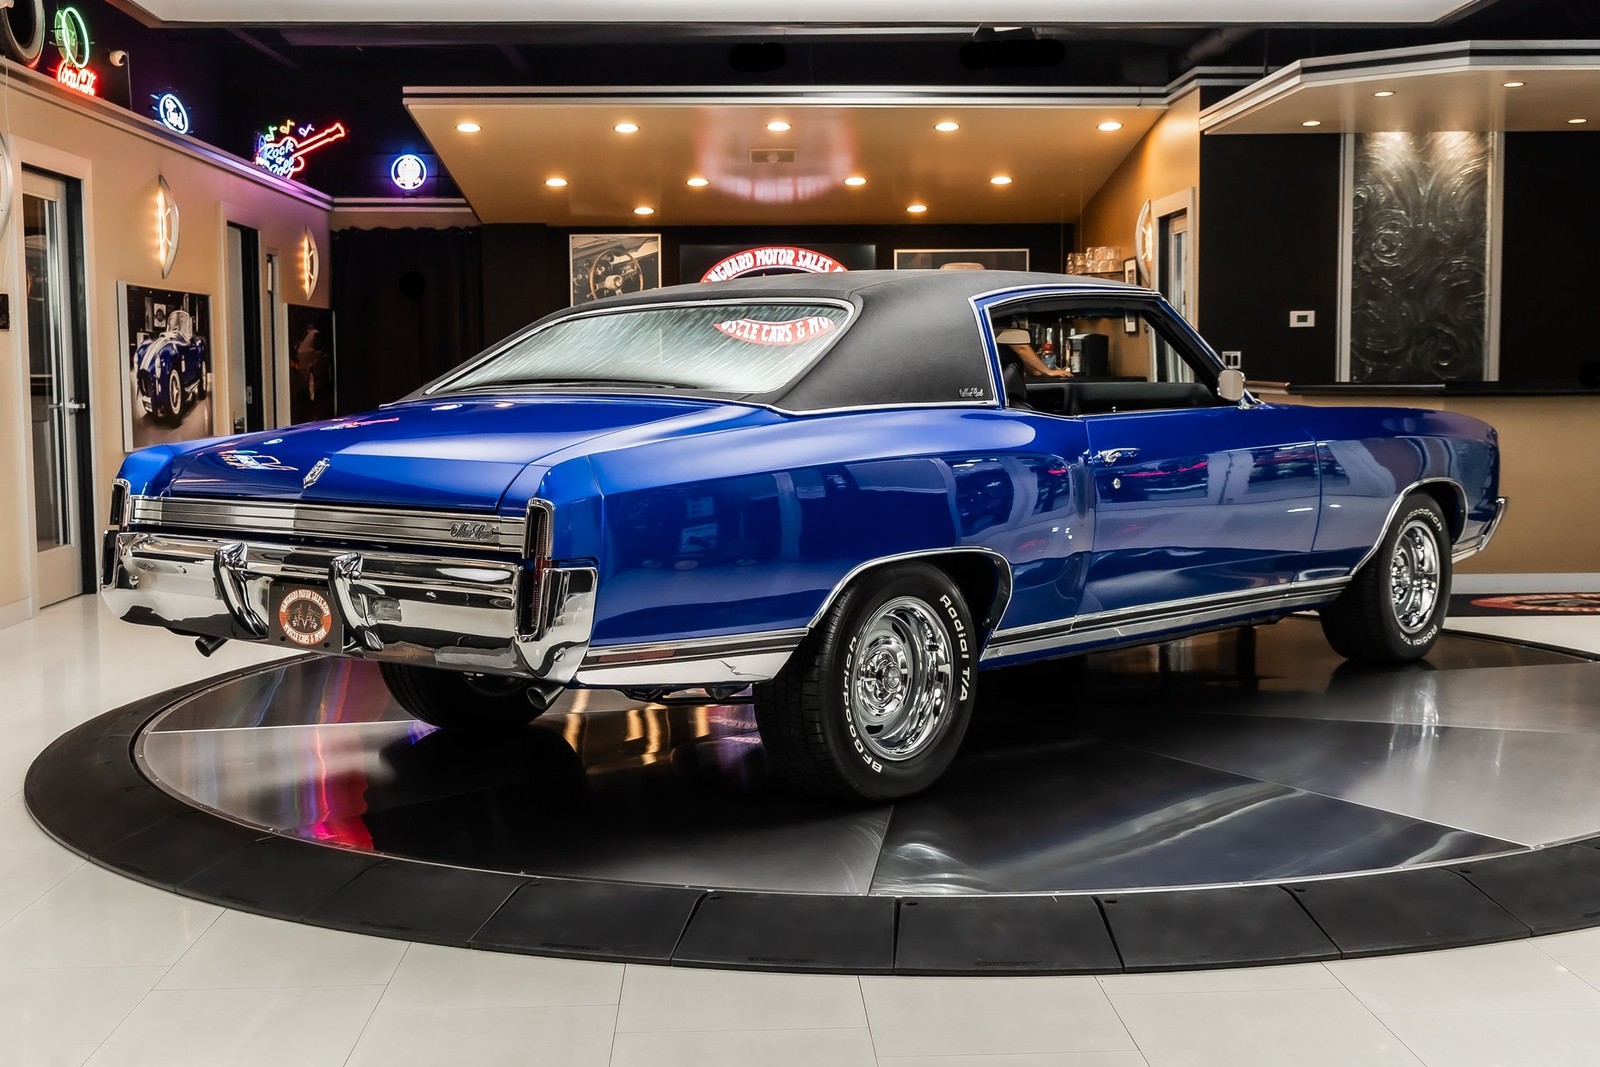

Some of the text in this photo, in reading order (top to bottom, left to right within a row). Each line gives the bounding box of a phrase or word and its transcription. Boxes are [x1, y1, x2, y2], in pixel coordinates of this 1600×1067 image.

[264, 139, 294, 160] Rock
[754, 248, 796, 266] MOTOR
[761, 323, 793, 343] CARS
[795, 320, 806, 339] &
[939, 594, 971, 702] Radial T/A
[842, 636, 883, 774] BFGoodrich
